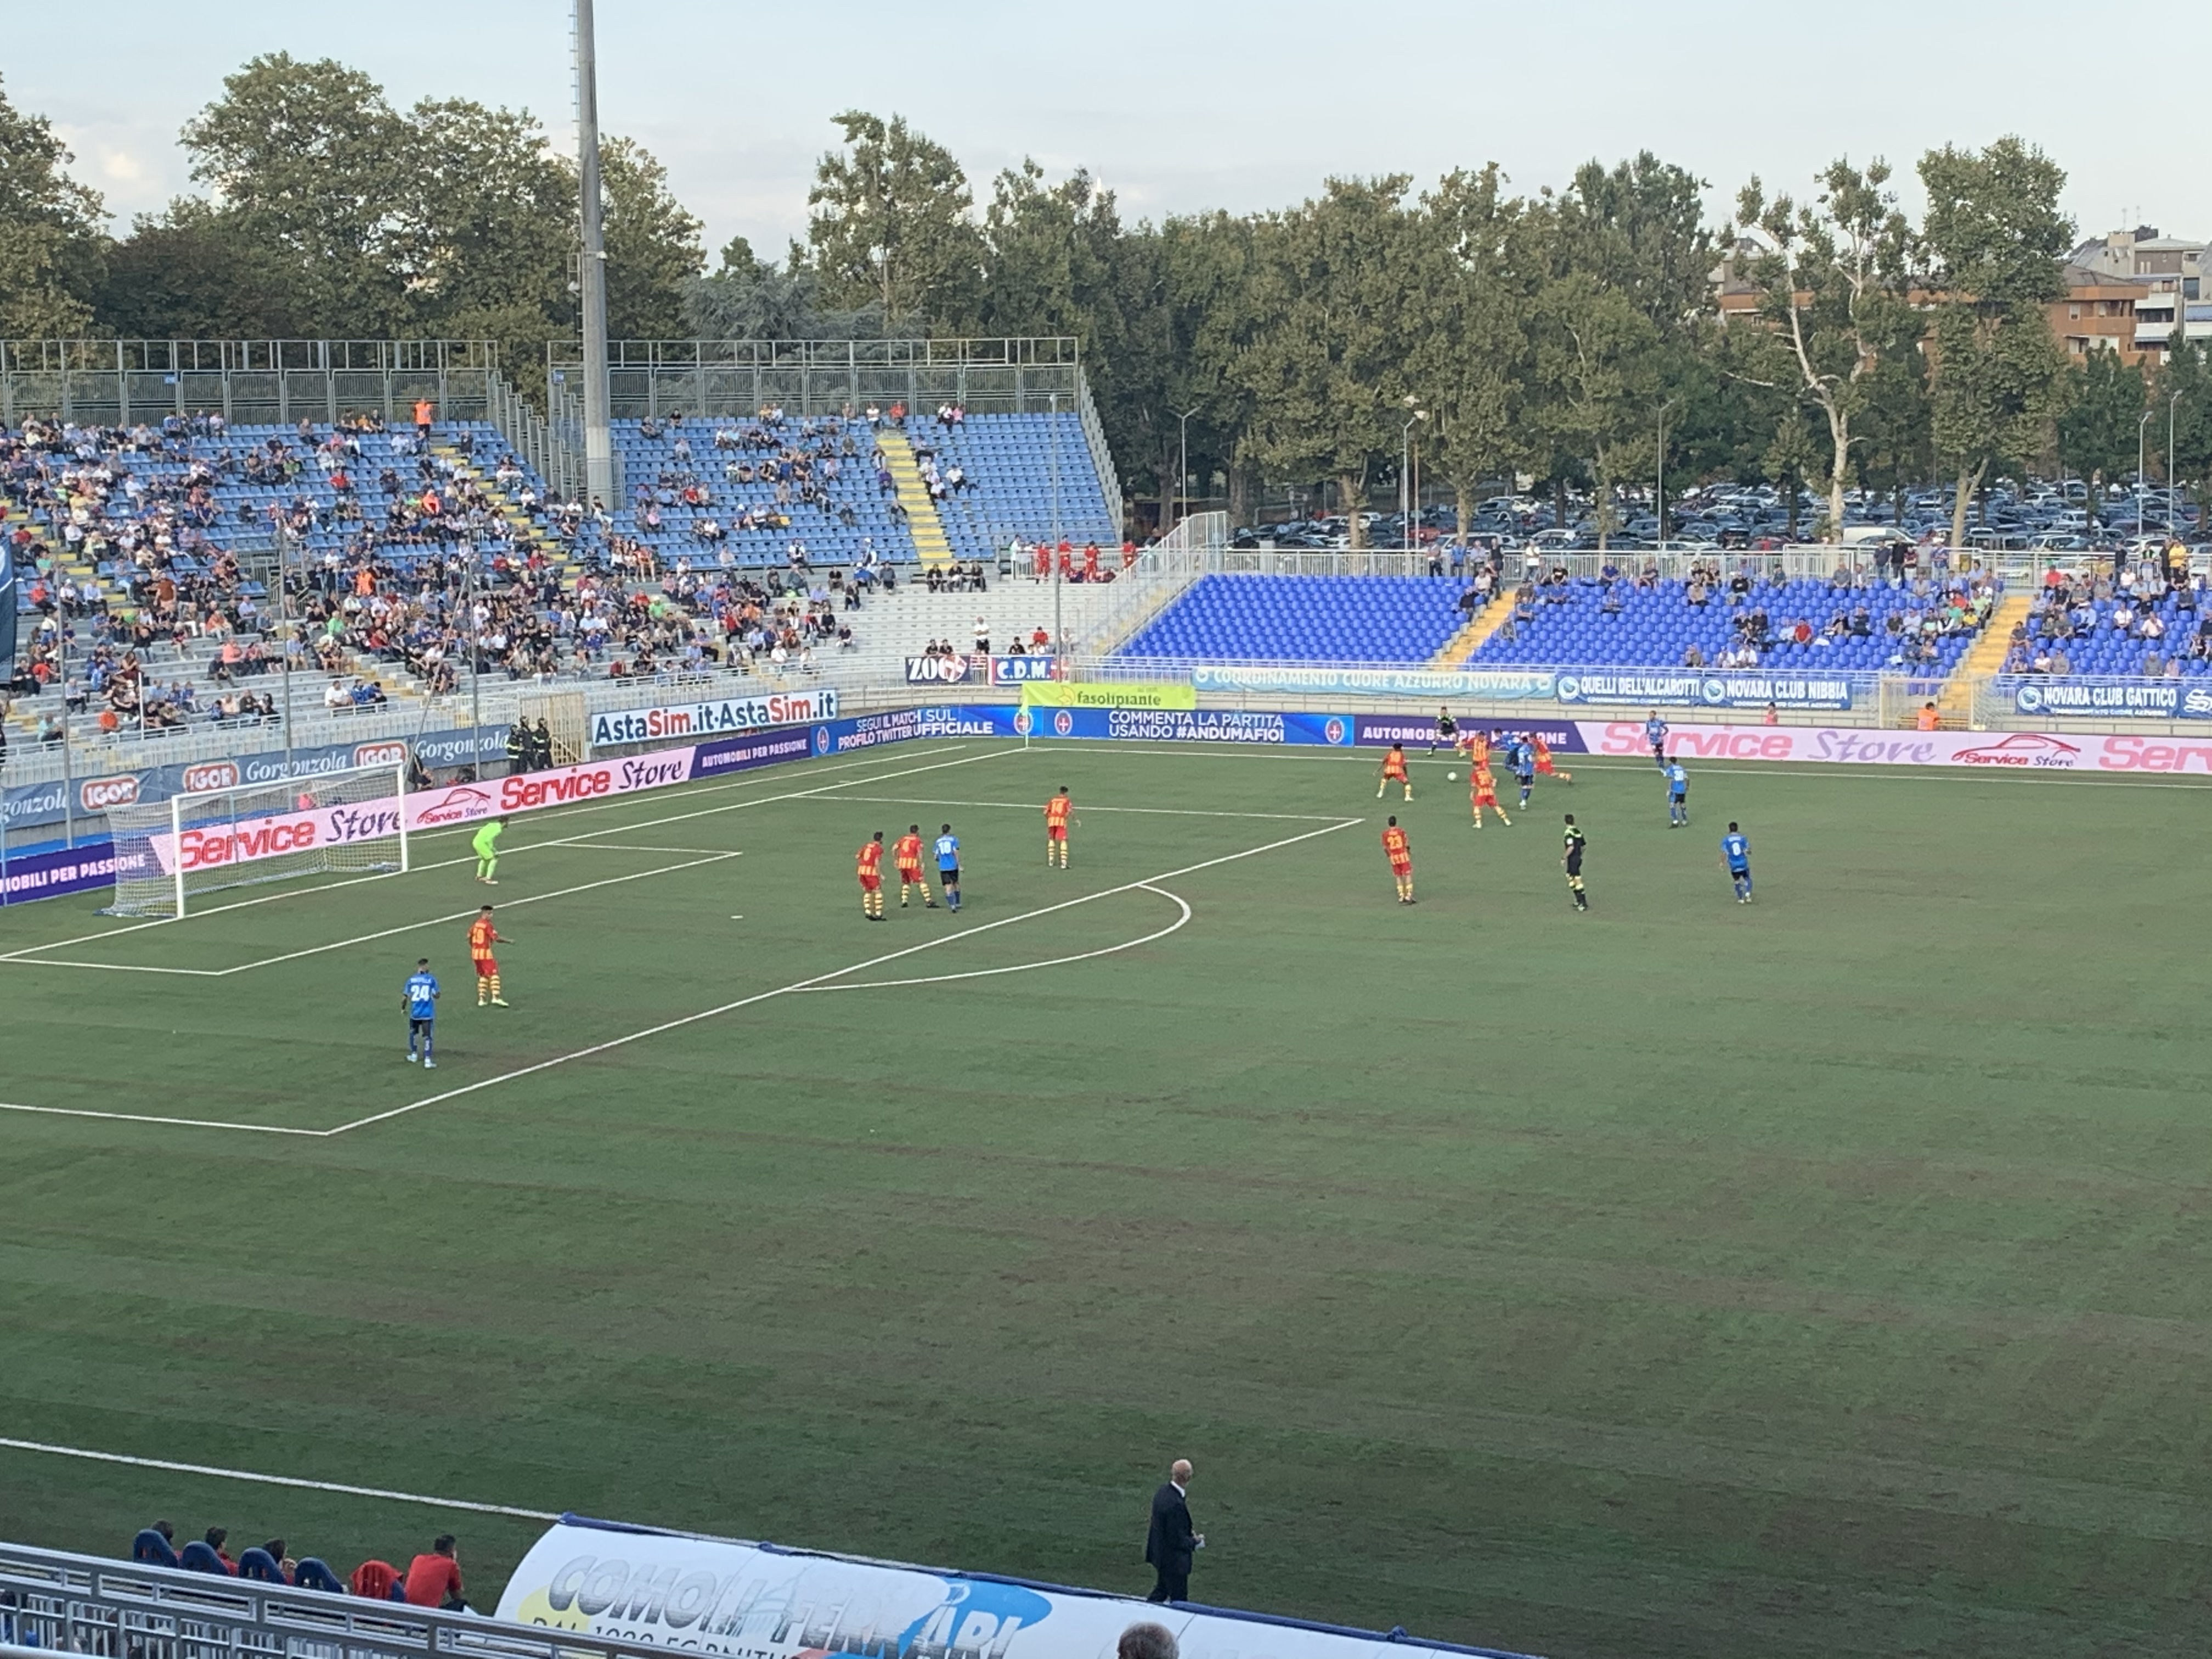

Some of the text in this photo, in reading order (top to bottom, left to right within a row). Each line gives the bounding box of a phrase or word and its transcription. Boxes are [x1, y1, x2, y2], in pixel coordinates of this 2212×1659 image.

[997, 661, 1050, 679] C.D.M.
[1214, 670, 1531, 690] COORDINAMENTO CUORE AZZURRO NOVARA
[1581, 676, 1700, 697] QUELLI DELL'ALCAROTTI
[1727, 680, 1848, 700] NOVARA CLUB NIBBIA
[2044, 687, 2177, 707] NOVARA CLUB GATTICO
[856, 718, 881, 732] SEGUI
[892, 710, 922, 727] MATCH
[926, 709, 957, 722] SUL
[1109, 710, 1285, 728] COMMENTA LA PARTITA
[838, 721, 994, 751] PROFILO TWITTER UFFICIALE
[1109, 725, 1173, 738] USANDO
[1363, 727, 1455, 741] AUTOMOB
[359, 746, 403, 767] IGOR
[702, 738, 808, 768] AUTOMOBILI PER PASSIONE
[1807, 730, 1937, 763] Store
[1964, 753, 2074, 767] Service Store
[190, 768, 234, 790] IGOR
[501, 760, 684, 810] Service Store
[87, 782, 136, 806] IGOR
[425, 806, 488, 824] Service Store
[178, 809, 407, 870] Service Store
[50, 866, 77, 884] PER
[80, 854, 145, 877] PASSIONE
[411, 985, 430, 1001] 24
